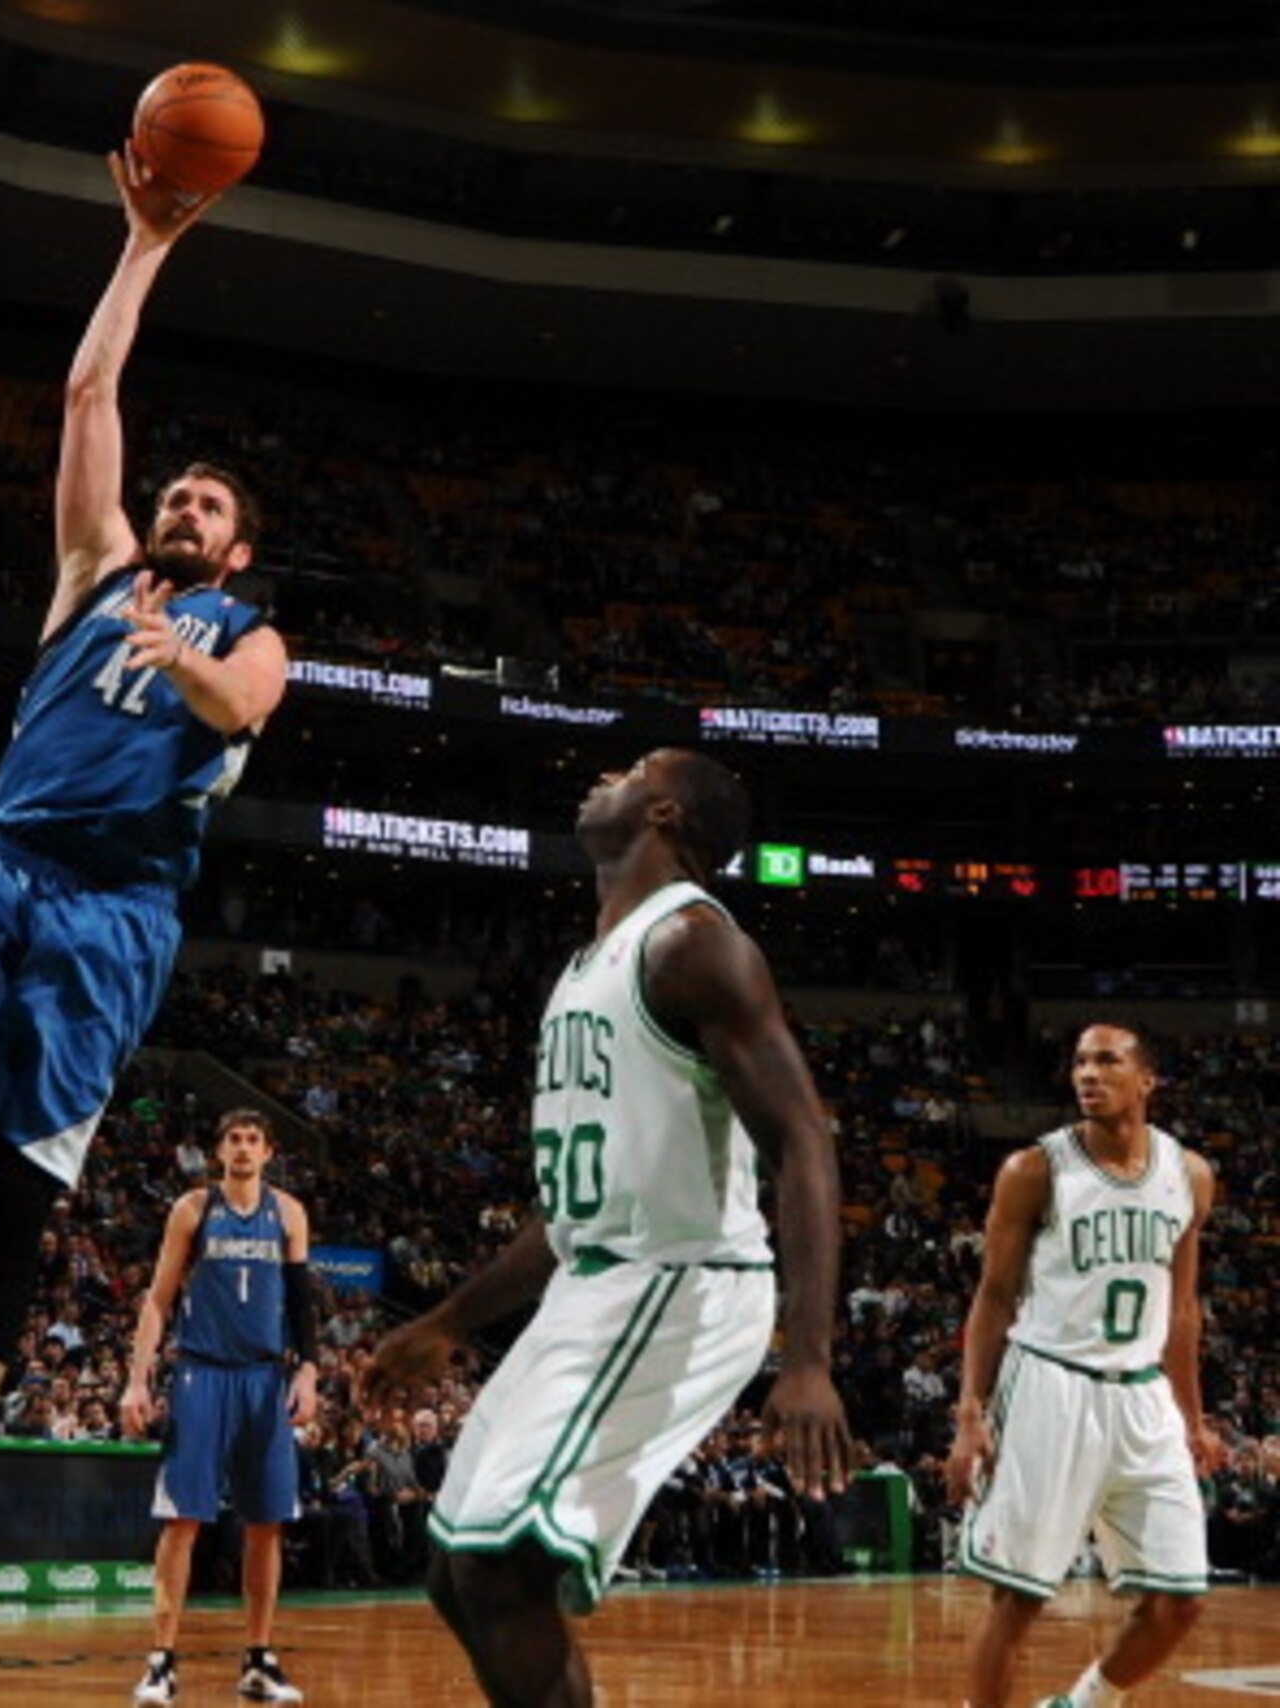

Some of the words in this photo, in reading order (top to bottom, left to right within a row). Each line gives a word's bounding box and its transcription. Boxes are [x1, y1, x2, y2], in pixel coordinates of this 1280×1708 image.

[334, 811, 529, 855] NBATICKETS.COM
[764, 850, 800, 879] TD
[807, 852, 875, 878] Bank
[533, 1120, 605, 1224] 30
[237, 1266, 249, 1304] 1
[1104, 1278, 1147, 1345] 0
